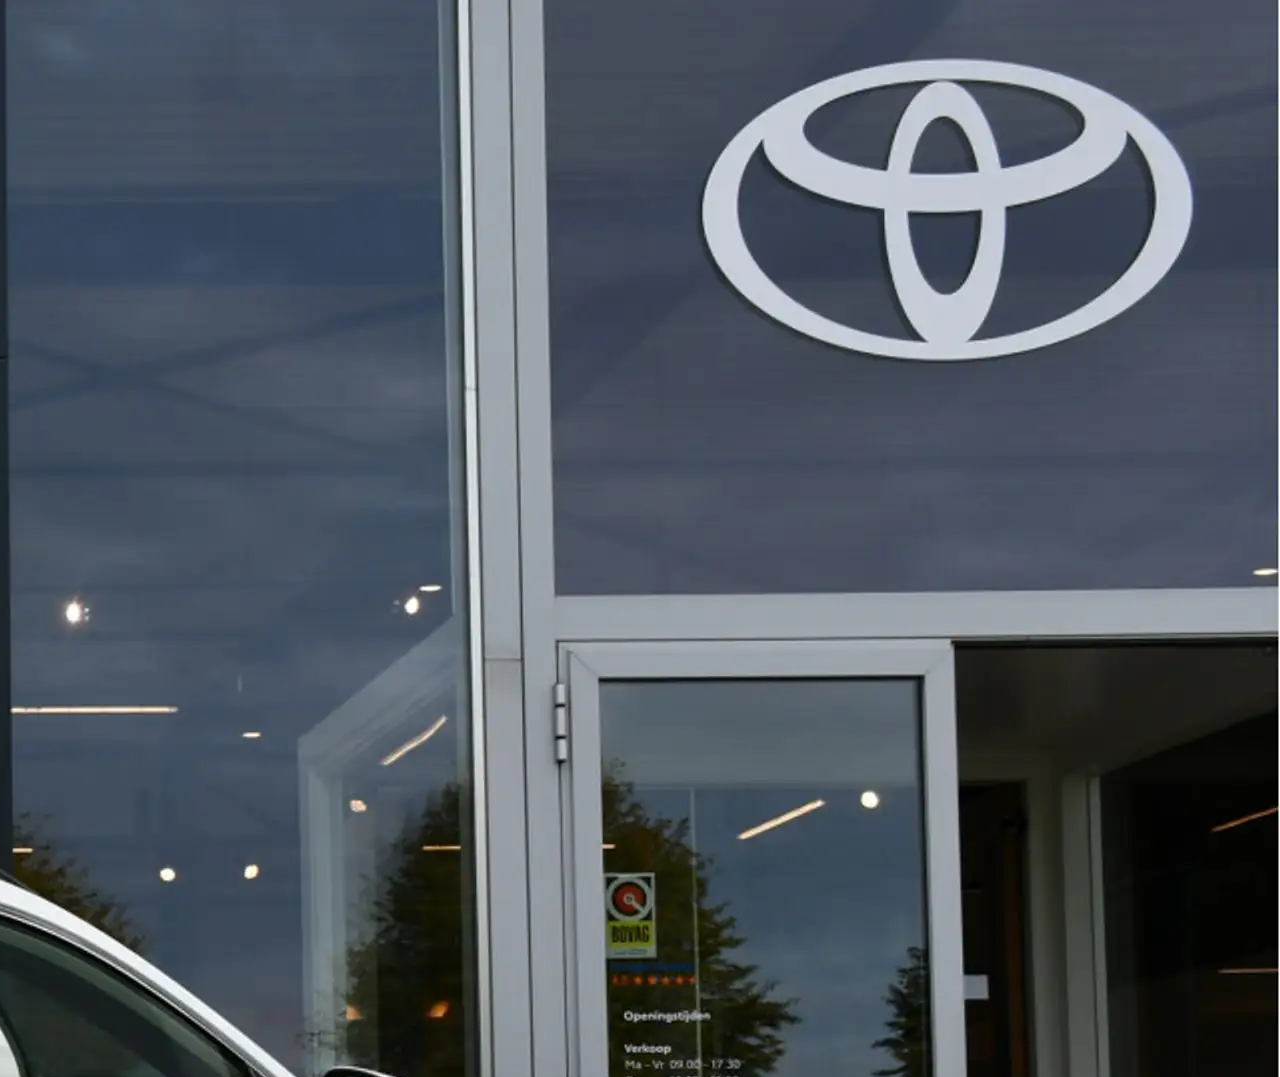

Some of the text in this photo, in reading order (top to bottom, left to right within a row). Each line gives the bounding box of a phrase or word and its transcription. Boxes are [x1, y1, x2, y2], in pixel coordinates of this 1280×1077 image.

[612, 924, 649, 943] BOVAG
[624, 1010, 711, 1023] Openingstijden
[624, 1043, 671, 1055] Verkoop
[625, 1060, 642, 1069] Ma
[652, 1060, 664, 1069] Vr
